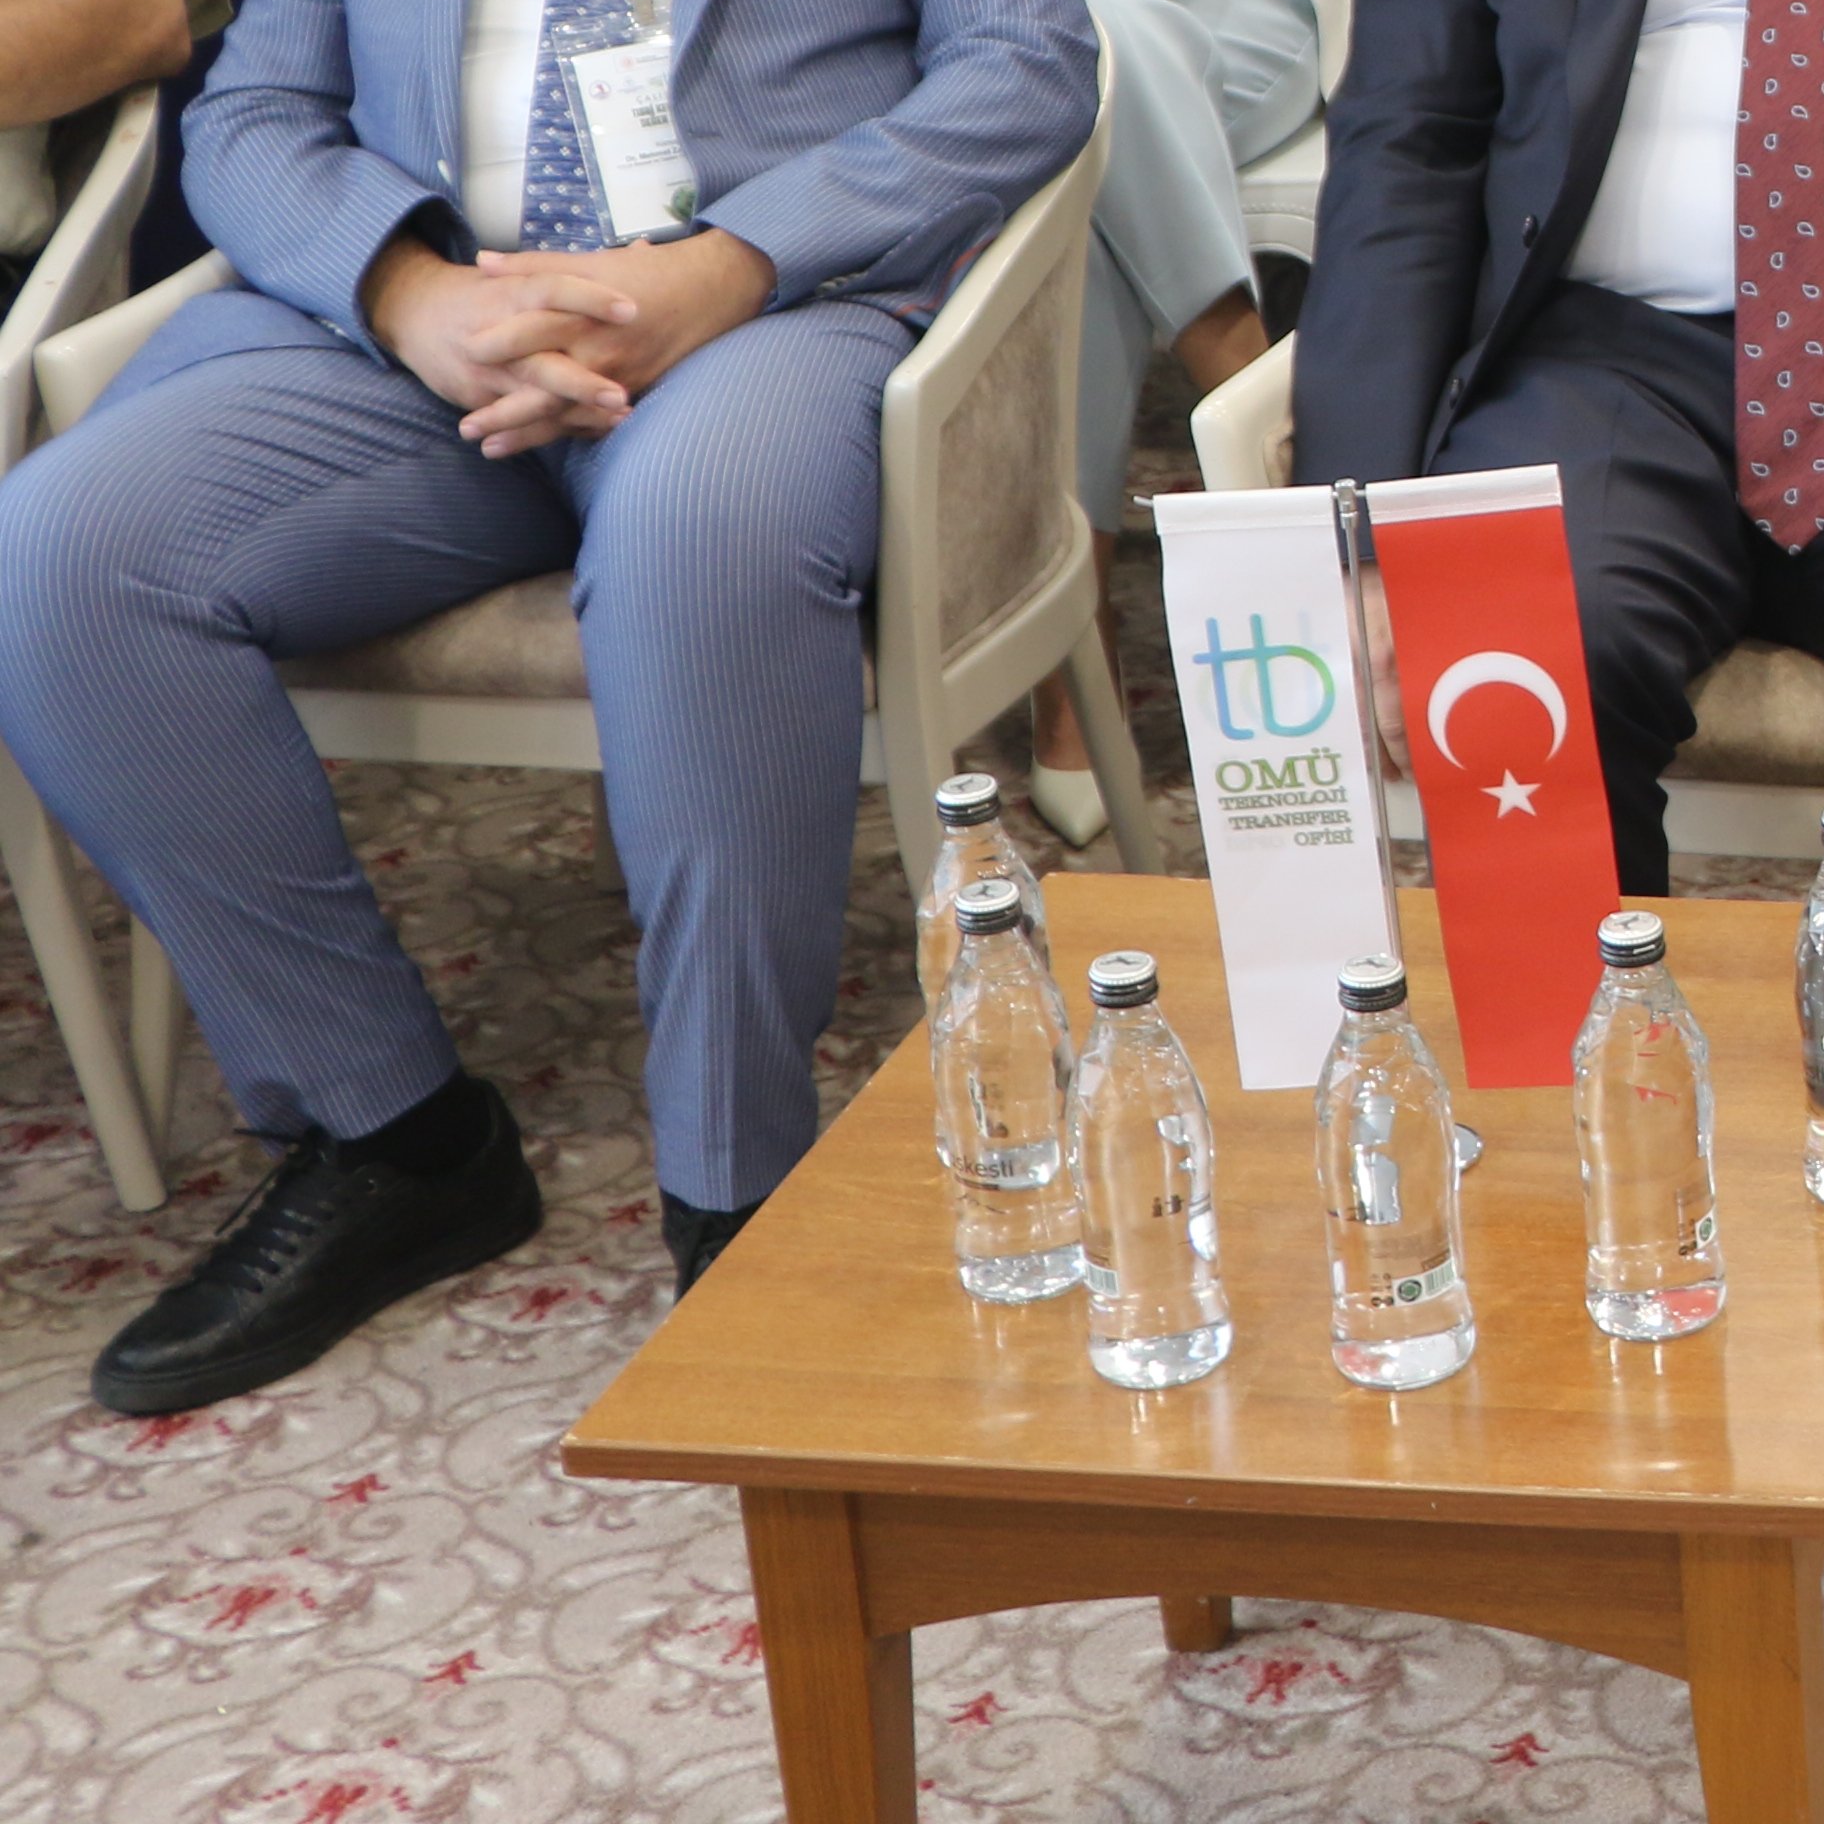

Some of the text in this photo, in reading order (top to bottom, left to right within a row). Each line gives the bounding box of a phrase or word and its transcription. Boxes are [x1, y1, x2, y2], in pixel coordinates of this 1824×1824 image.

[1215, 747, 1341, 793] OMÜ
[1218, 786, 1348, 811] TEKNOLOJİ
[1228, 810, 1351, 830] TRANSFER
[1294, 829, 1354, 847] OFİSİ
